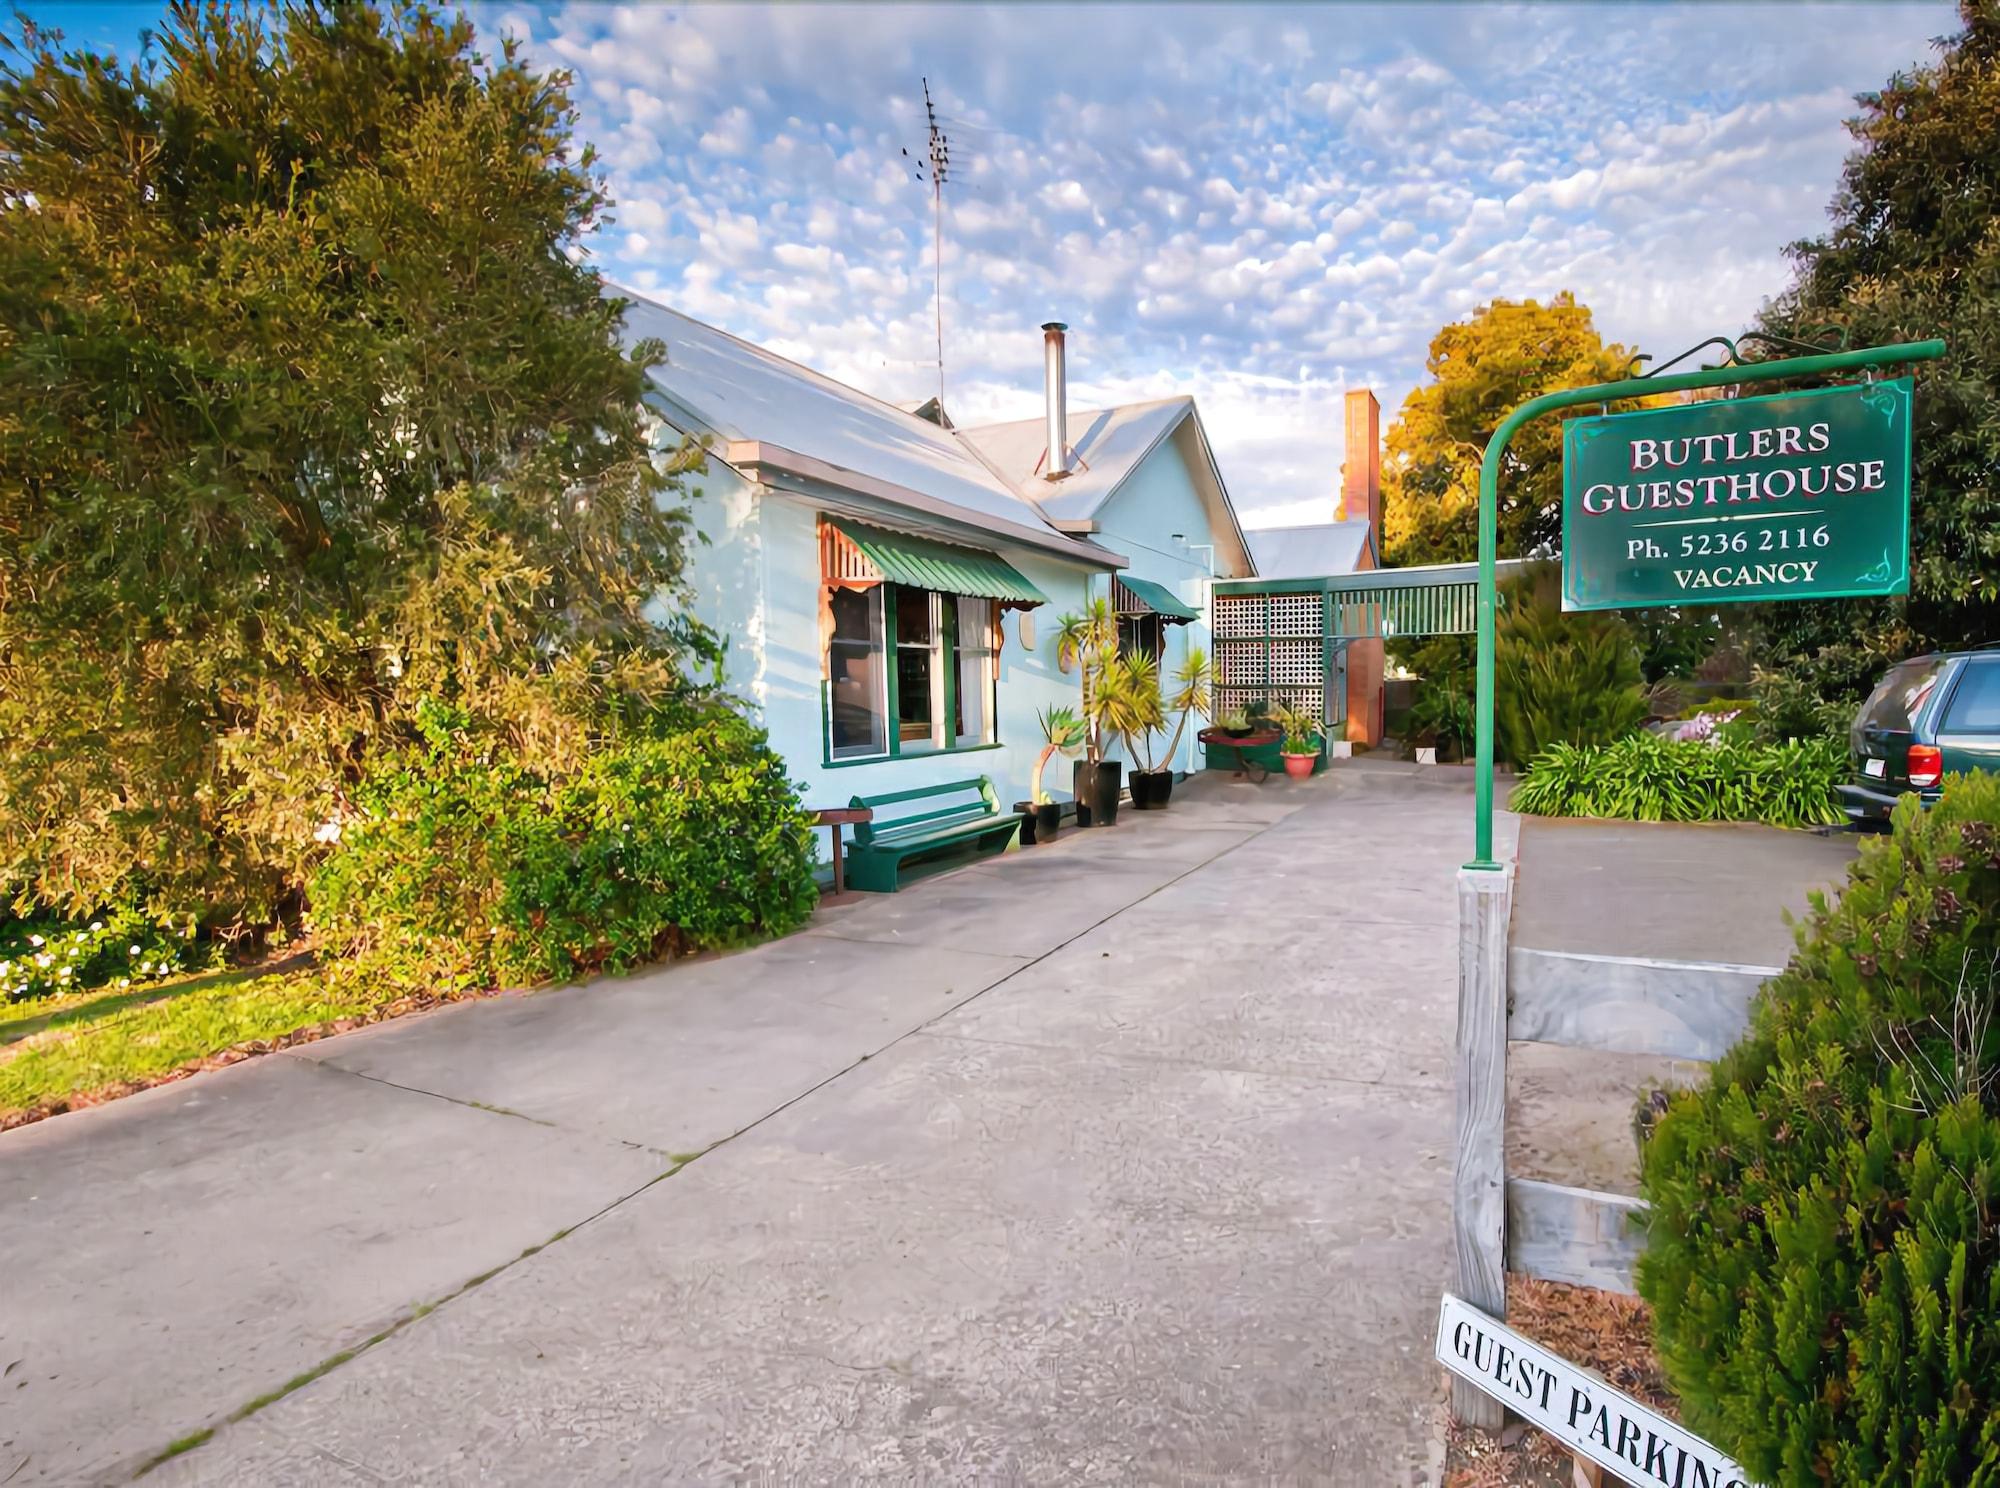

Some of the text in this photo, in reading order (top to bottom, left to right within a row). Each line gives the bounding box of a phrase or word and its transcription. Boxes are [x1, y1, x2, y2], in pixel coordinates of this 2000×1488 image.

[1629, 423, 1830, 471] BUTLERS
[1582, 461, 1886, 515] GUESTHOUSE
[1627, 524, 1830, 560] Ph. 5236 2116
[1674, 561, 1818, 589] VACANCY
[1454, 1321, 1750, 1488] GUEST PARKIN
